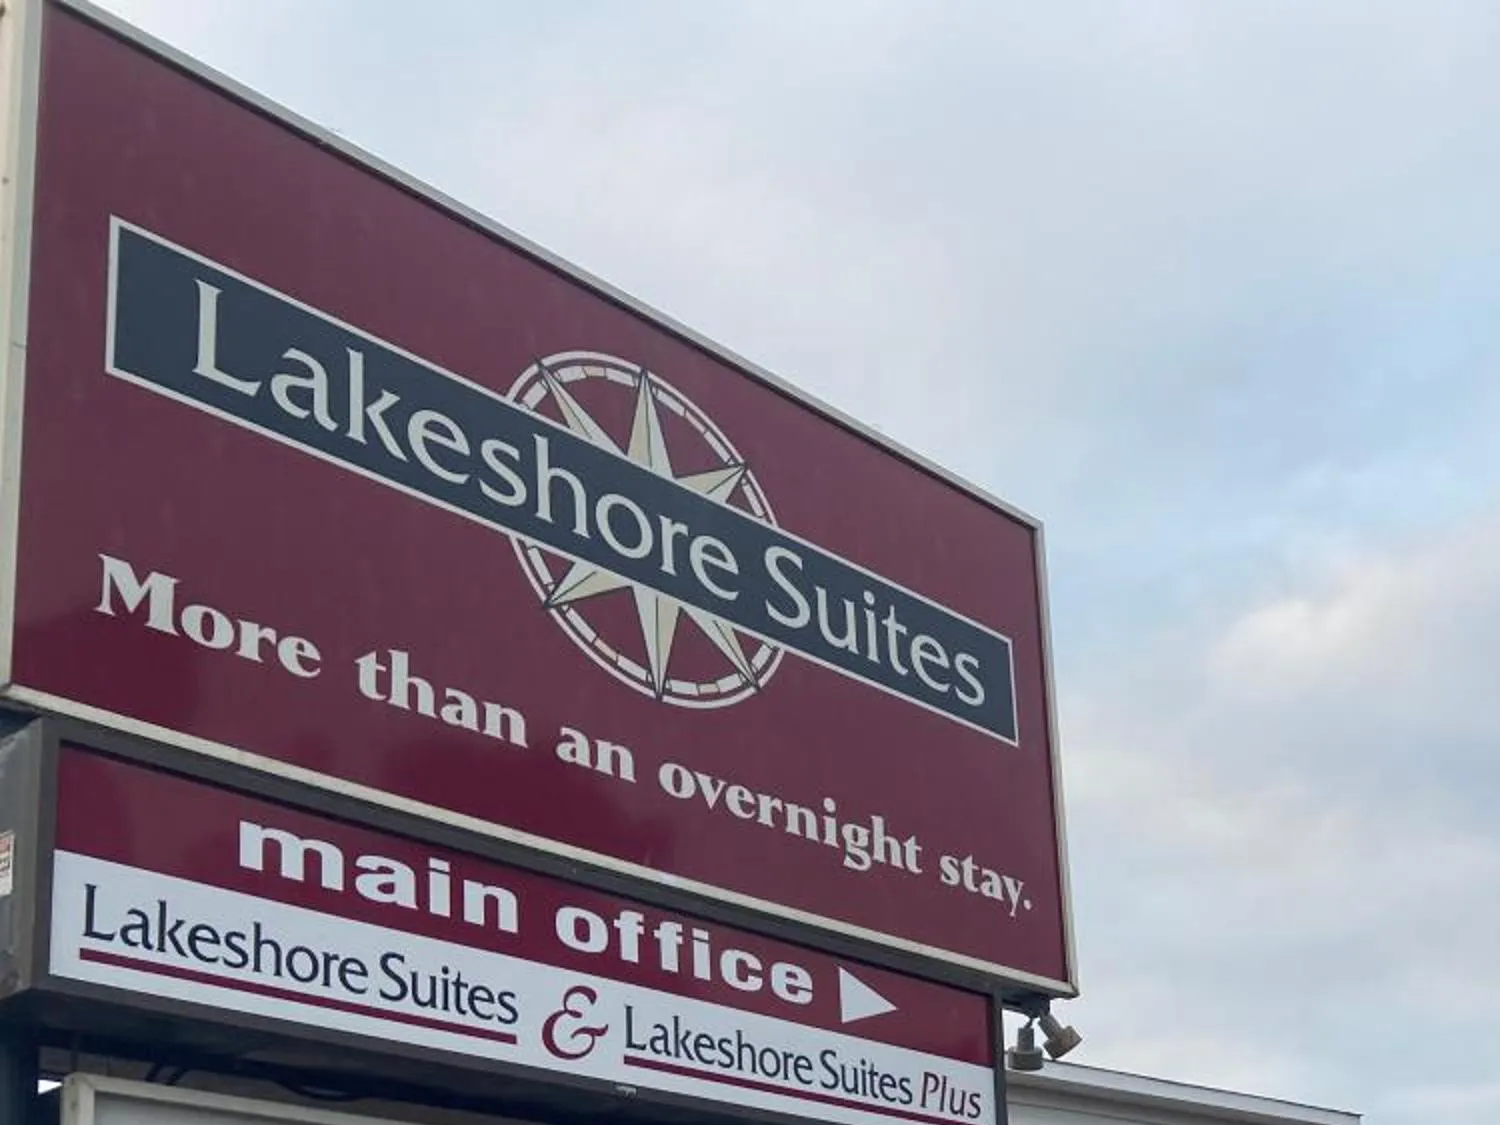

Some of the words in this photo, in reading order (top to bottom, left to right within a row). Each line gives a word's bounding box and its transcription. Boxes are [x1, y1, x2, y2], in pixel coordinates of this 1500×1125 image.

[192, 279, 739, 601] Lakeshore
[764, 546, 985, 706] Suites
[95, 553, 321, 678] More
[355, 649, 528, 748] than
[556, 727, 637, 783] an
[658, 763, 923, 874] overnight
[939, 855, 1032, 917] stay.
[82, 883, 369, 995] Lakeshore
[379, 952, 519, 1025] Suites
[541, 985, 609, 1061] &
[625, 1005, 814, 1085] Lakeshore
[819, 1049, 913, 1105] Suites
[920, 1071, 981, 1119] Plus
[239, 820, 518, 933] main
[555, 906, 813, 1005] office
